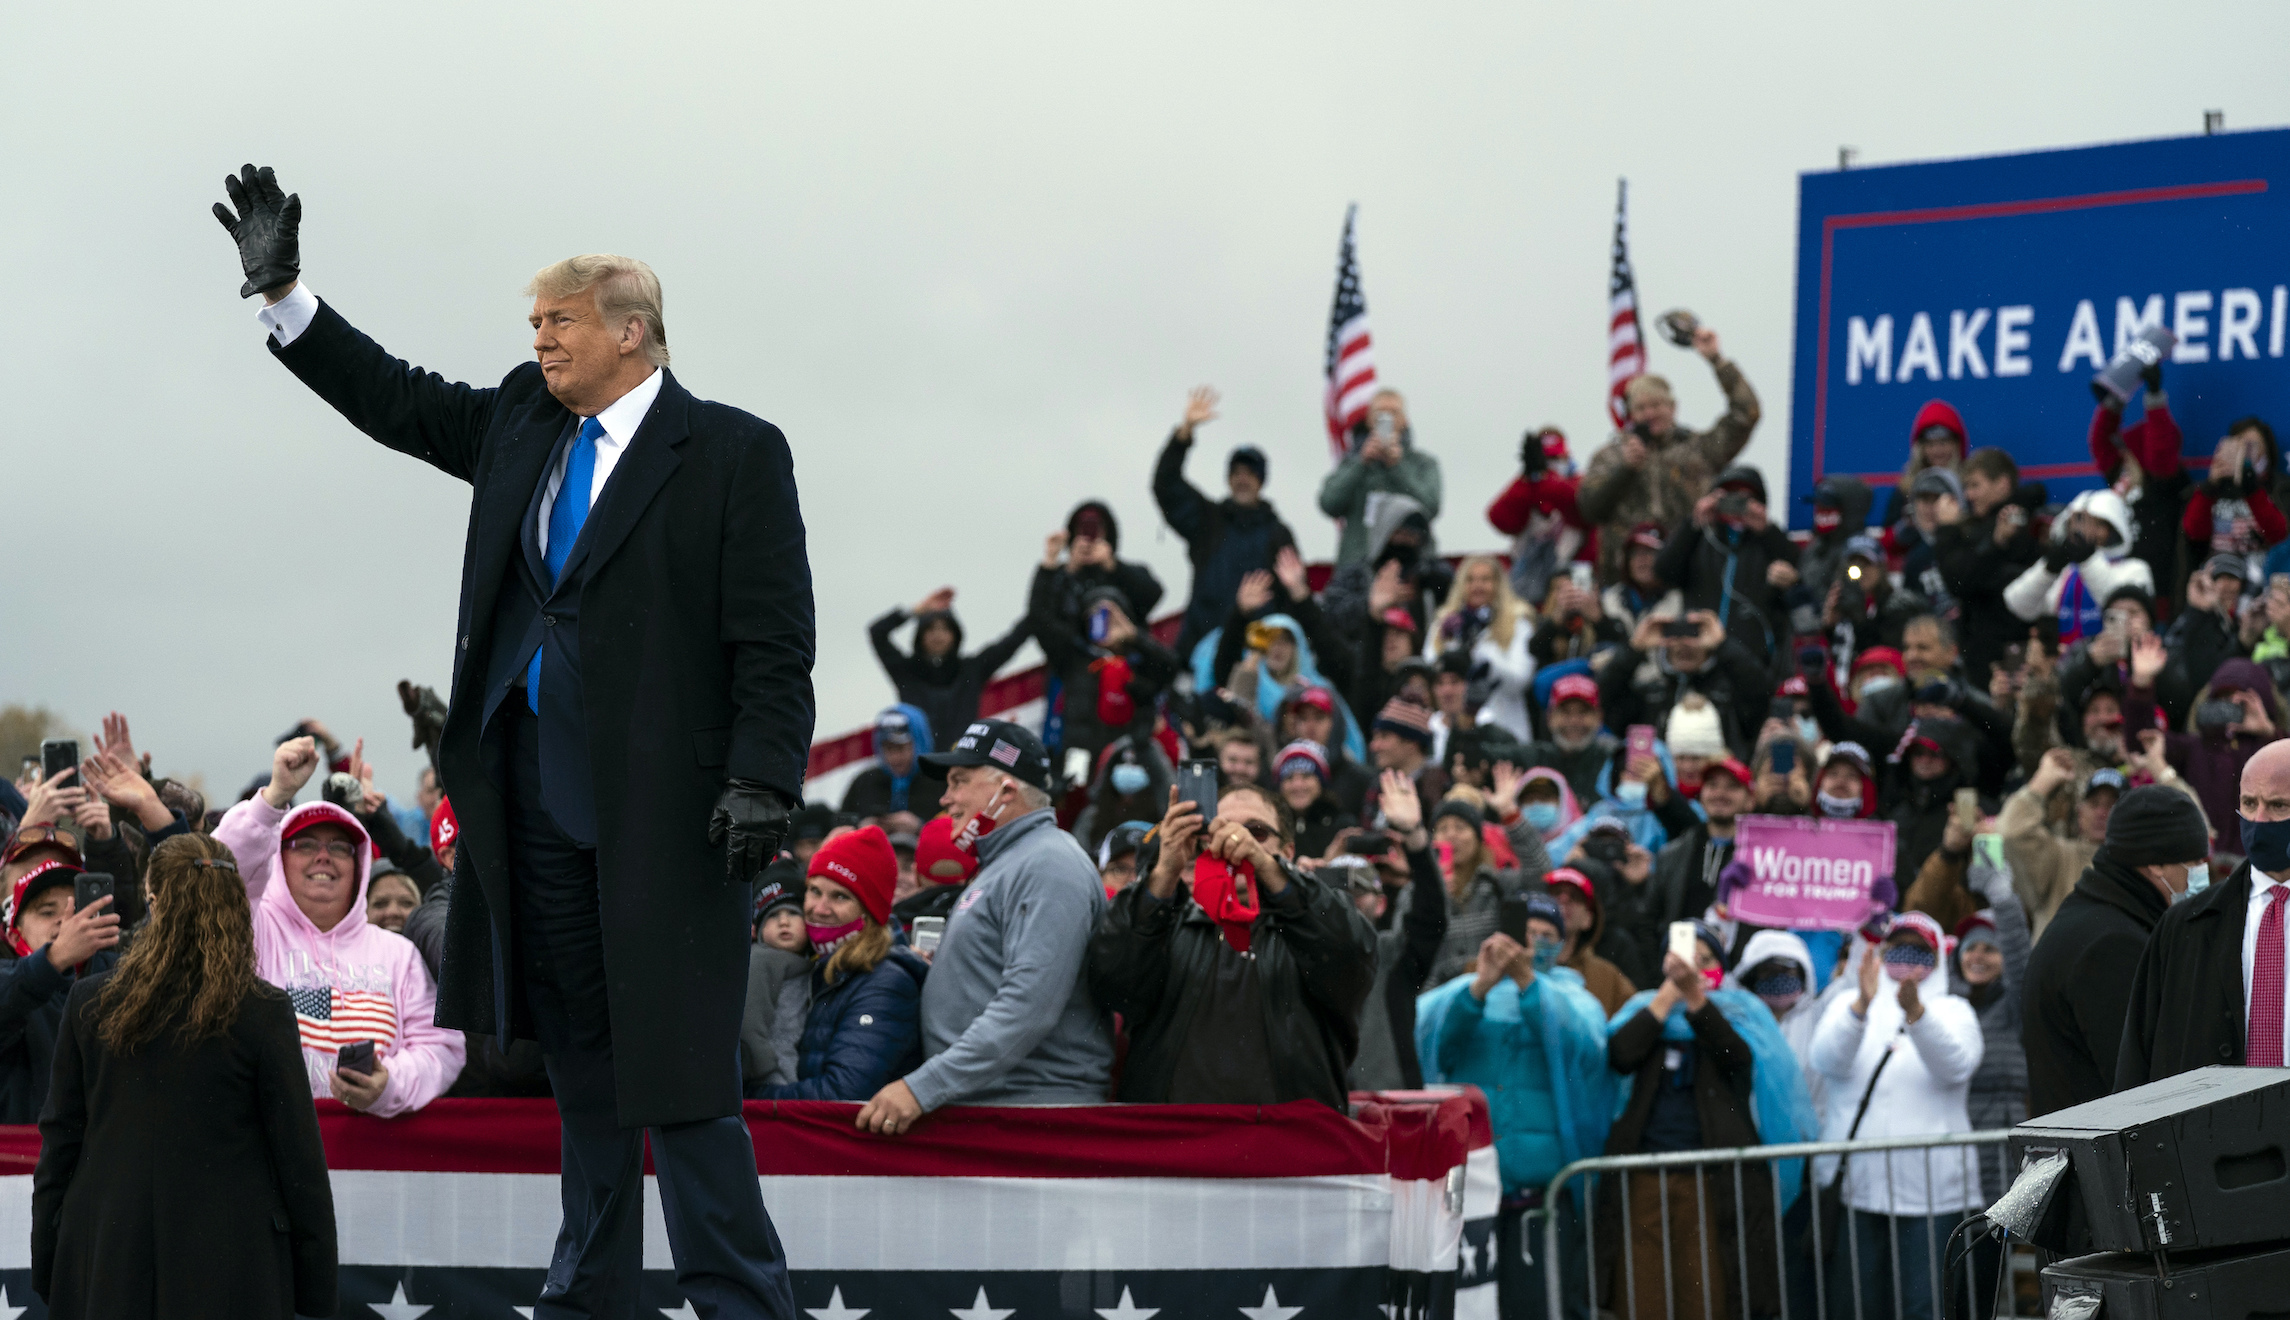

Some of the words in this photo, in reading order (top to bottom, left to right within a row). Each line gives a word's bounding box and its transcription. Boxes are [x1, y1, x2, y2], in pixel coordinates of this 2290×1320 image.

[1846, 304, 2036, 386] MAKE
[438, 817, 455, 844] 45
[18, 865, 44, 886] MAKE
[827, 861, 858, 882] 2020
[1753, 845, 1873, 888] Women
[1762, 882, 1799, 898] FOR
[1803, 884, 1860, 900] TRUMP
